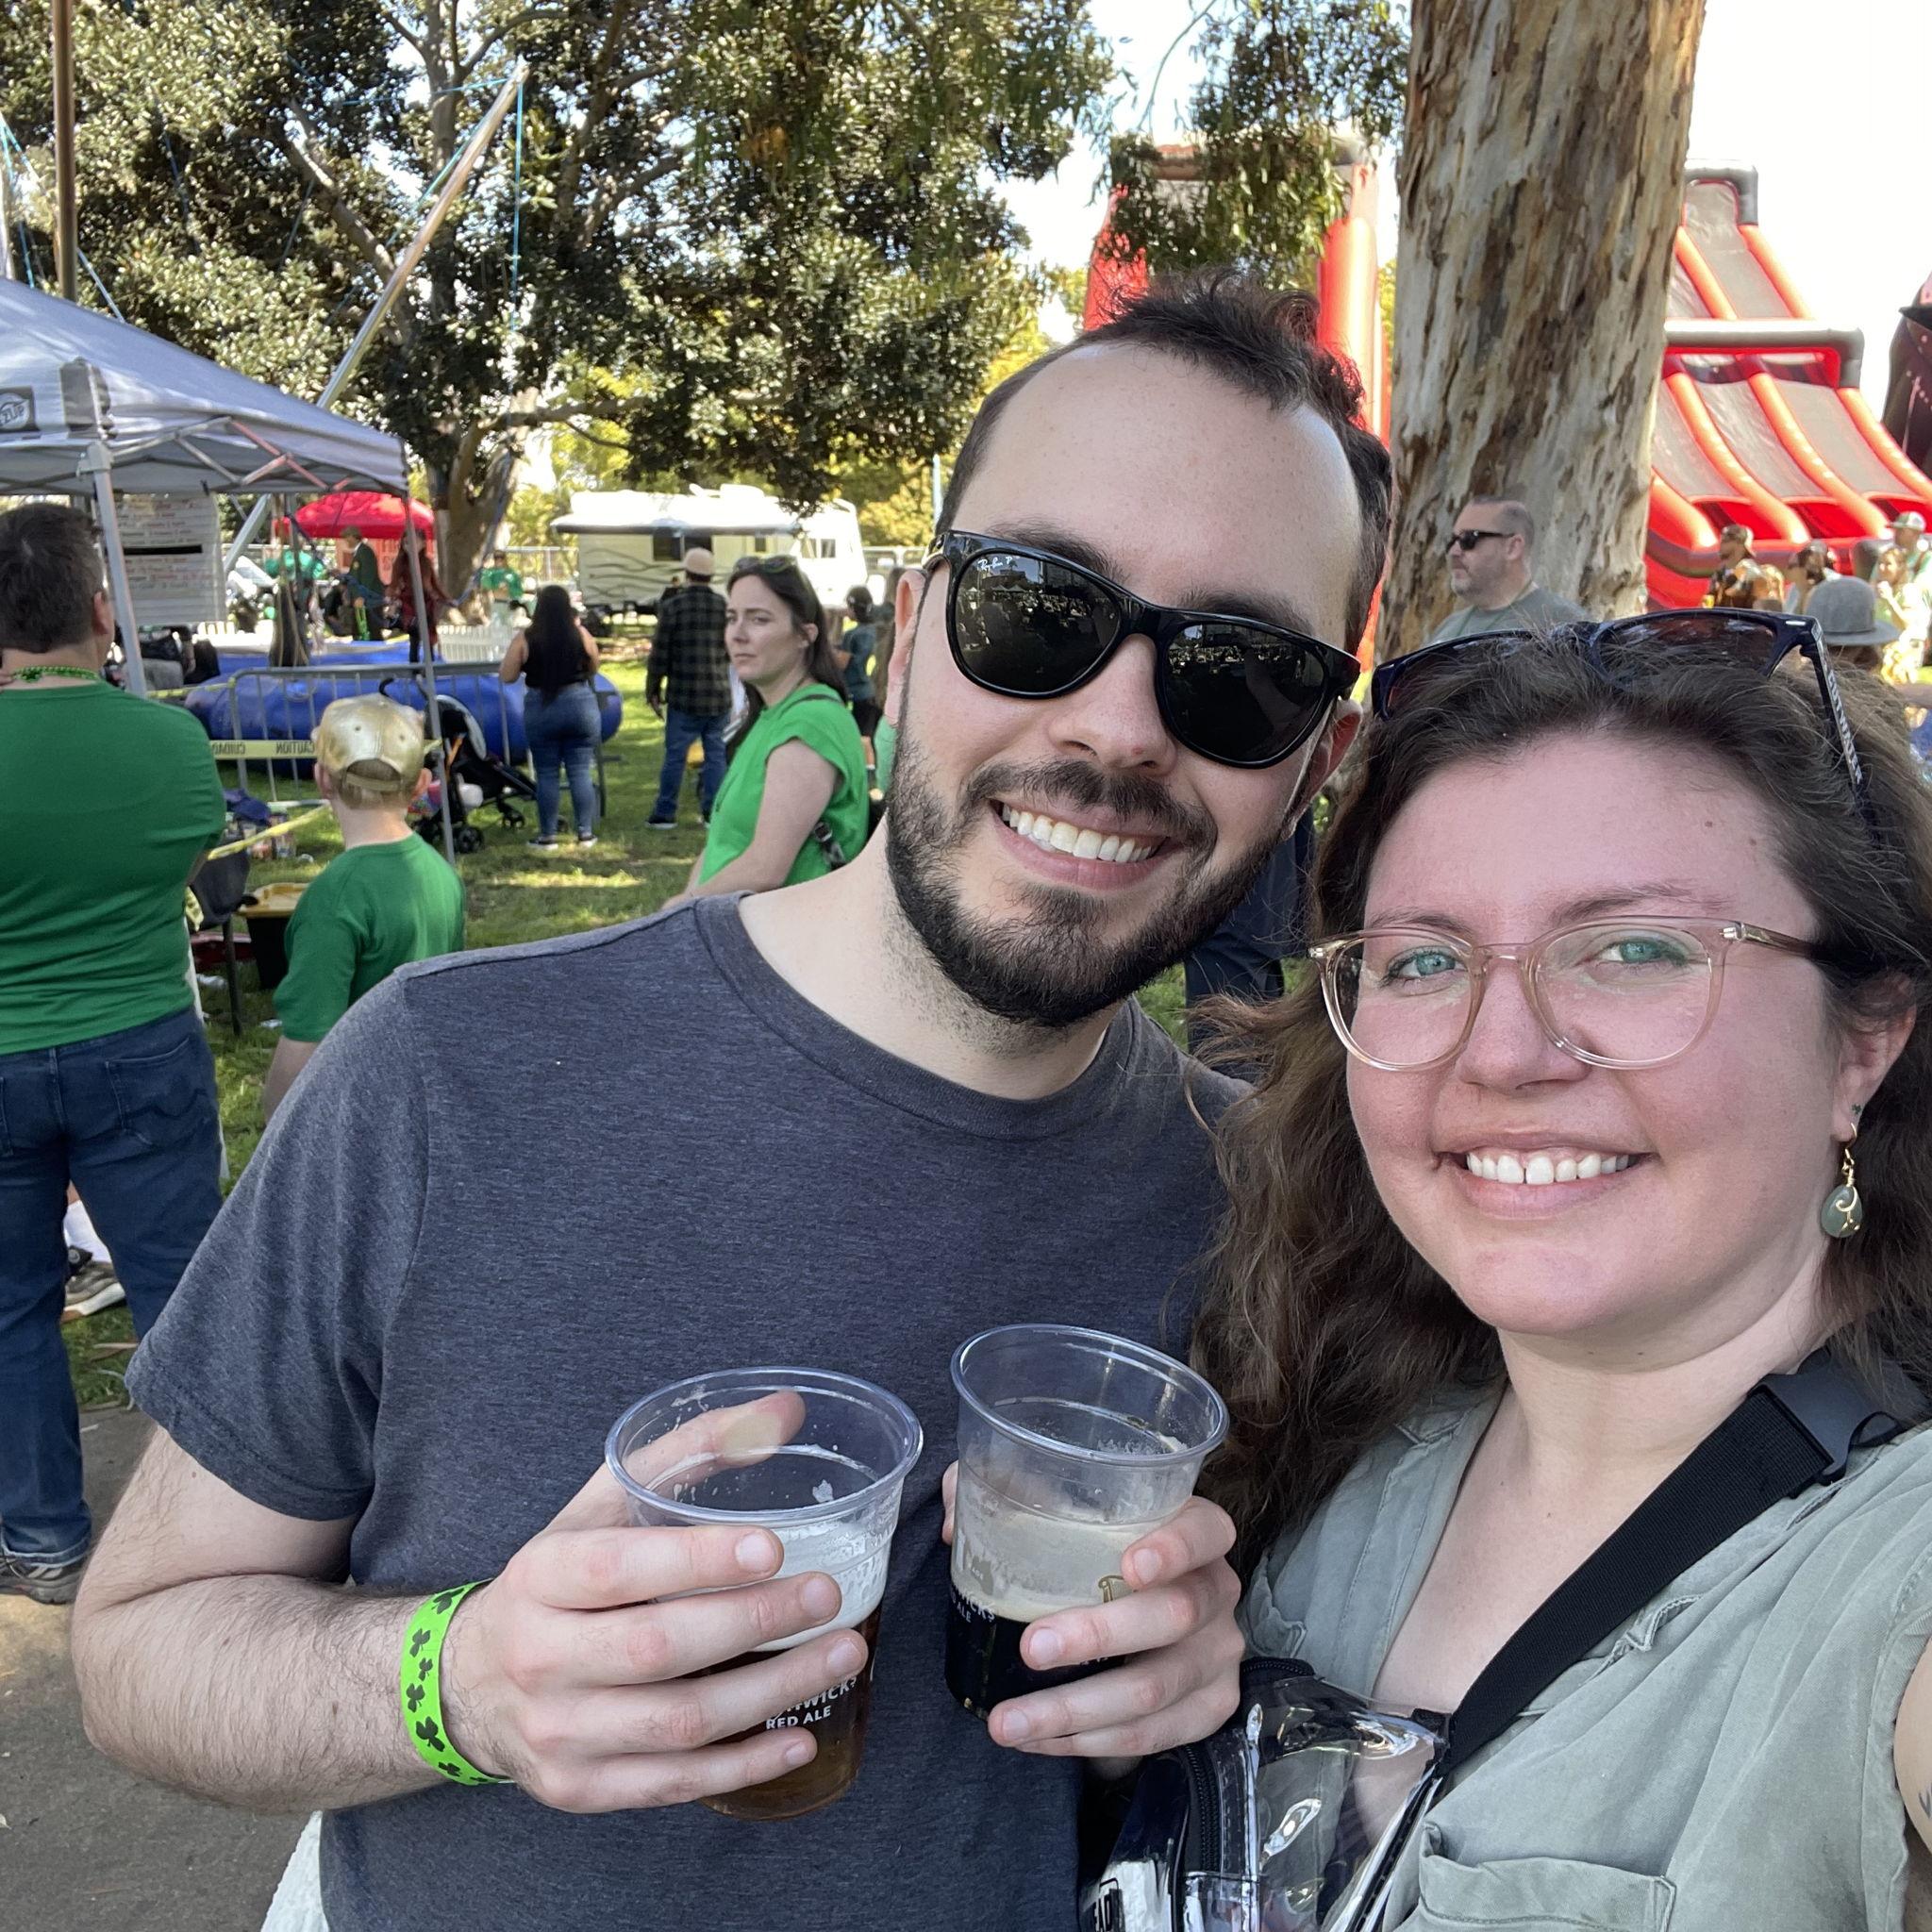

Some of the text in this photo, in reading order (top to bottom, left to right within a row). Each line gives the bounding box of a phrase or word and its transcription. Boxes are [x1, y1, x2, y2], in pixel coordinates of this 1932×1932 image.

[0, 405, 25, 425] ZUP
[765, 1705, 831, 1730] RED ALE
